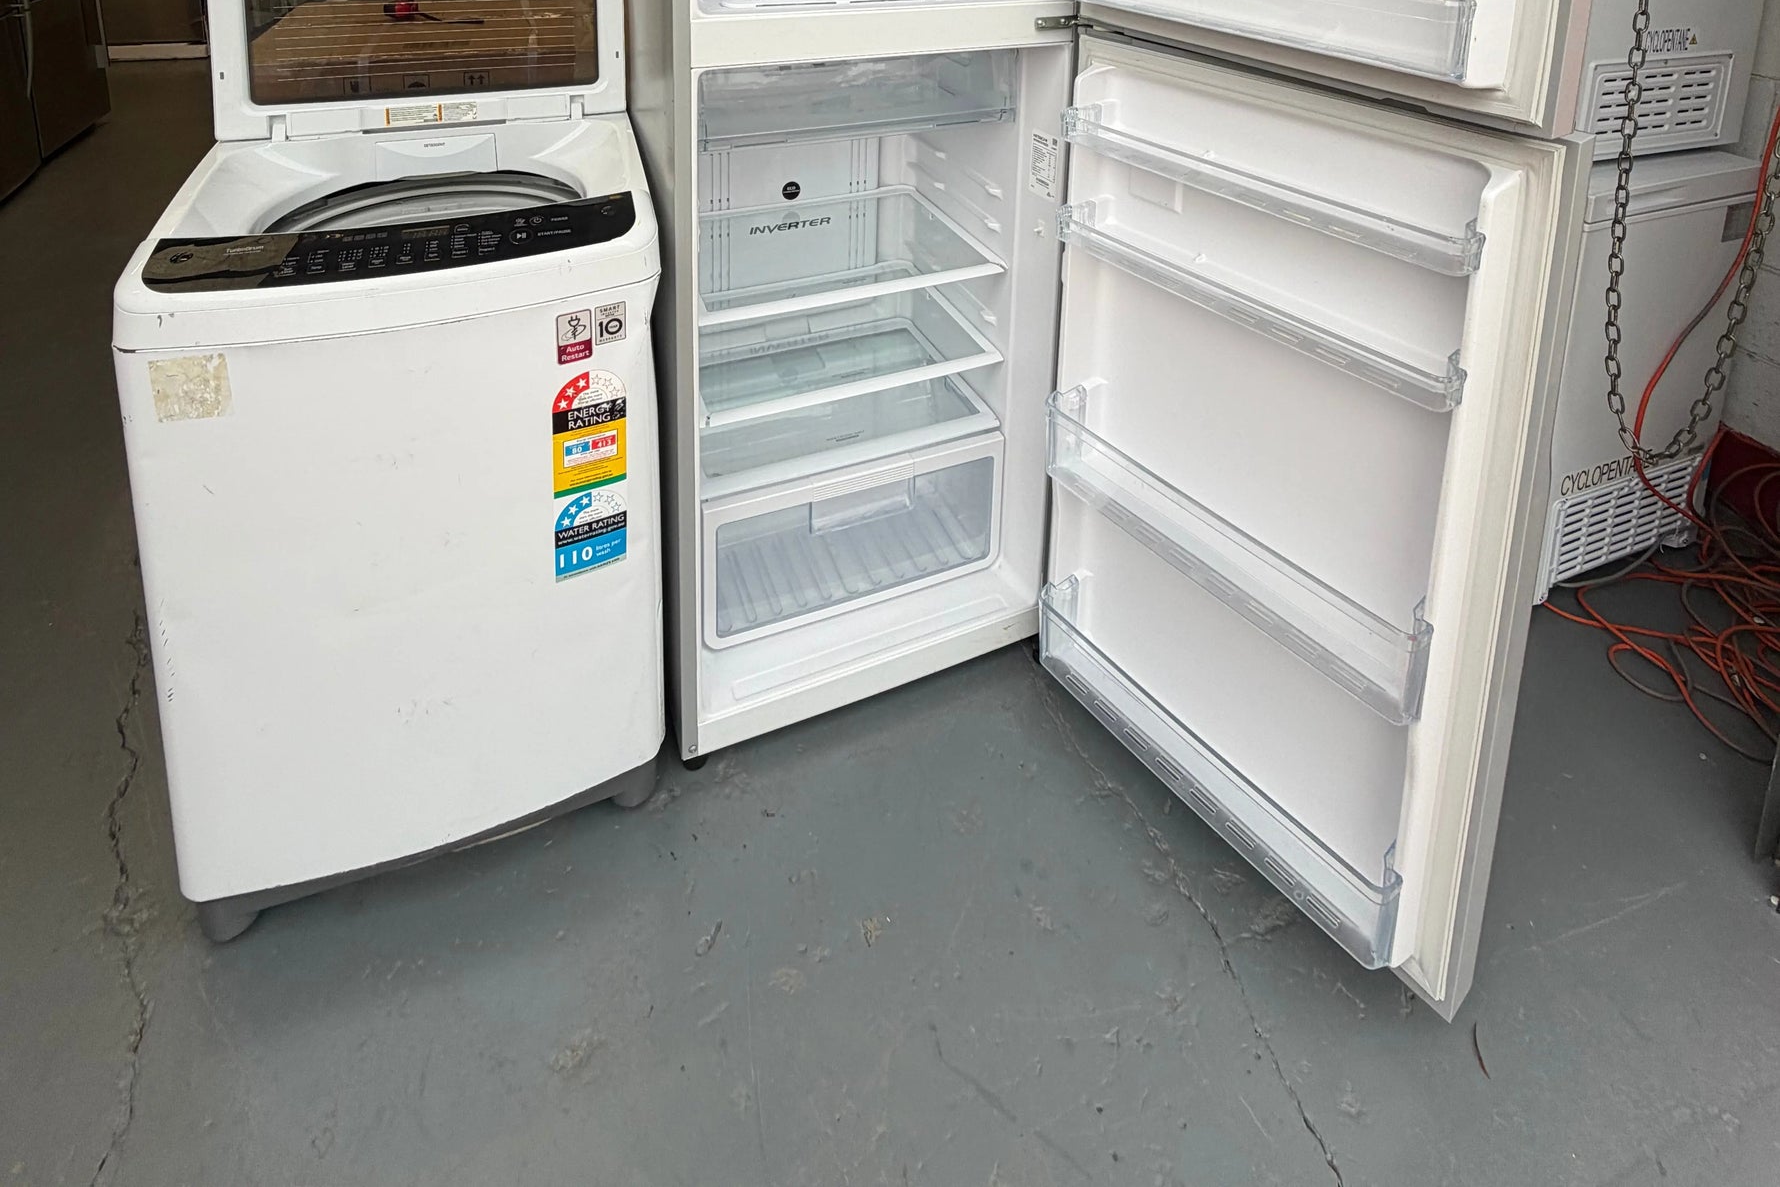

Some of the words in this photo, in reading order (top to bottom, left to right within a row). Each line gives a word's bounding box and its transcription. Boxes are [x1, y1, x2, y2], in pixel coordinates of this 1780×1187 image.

[1645, 28, 1691, 53] CYCLOPENTANE
[749, 216, 832, 235] INVERTER
[600, 305, 620, 313] SMART
[599, 318, 623, 338] 10
[561, 350, 590, 362] Restart
[566, 344, 585, 353] Auto
[567, 403, 611, 421] ENERGY
[568, 413, 610, 429] RATING
[572, 446, 583, 454] 80
[597, 439, 611, 448] 413
[558, 525, 589, 540] WATER
[592, 514, 625, 531] RATING
[560, 546, 593, 569] 110
